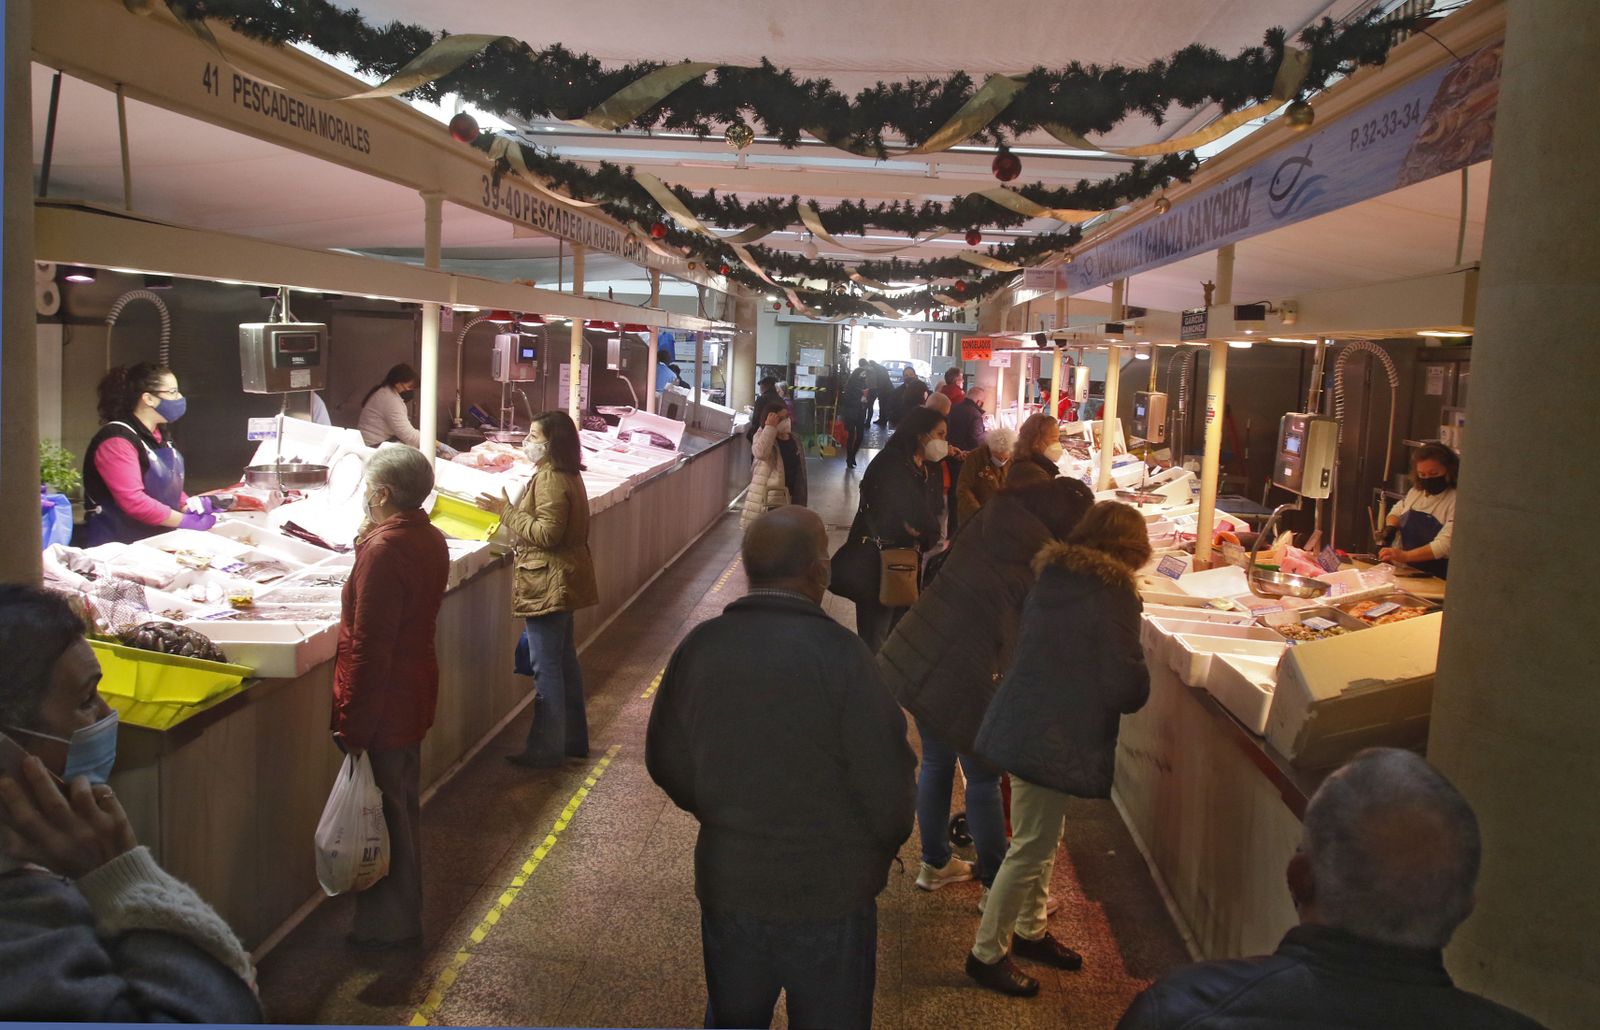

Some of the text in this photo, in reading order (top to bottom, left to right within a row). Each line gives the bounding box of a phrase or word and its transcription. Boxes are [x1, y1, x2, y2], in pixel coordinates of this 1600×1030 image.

[202, 62, 371, 155] 41 PESCADERIA MORALES
[1349, 97, 1421, 153] P.32-33-34
[481, 174, 521, 220] 39-40
[594, 223, 621, 254] RUEDA
[1144, 208, 1184, 264] GARCIA
[1185, 176, 1254, 251] SANCHEZ
